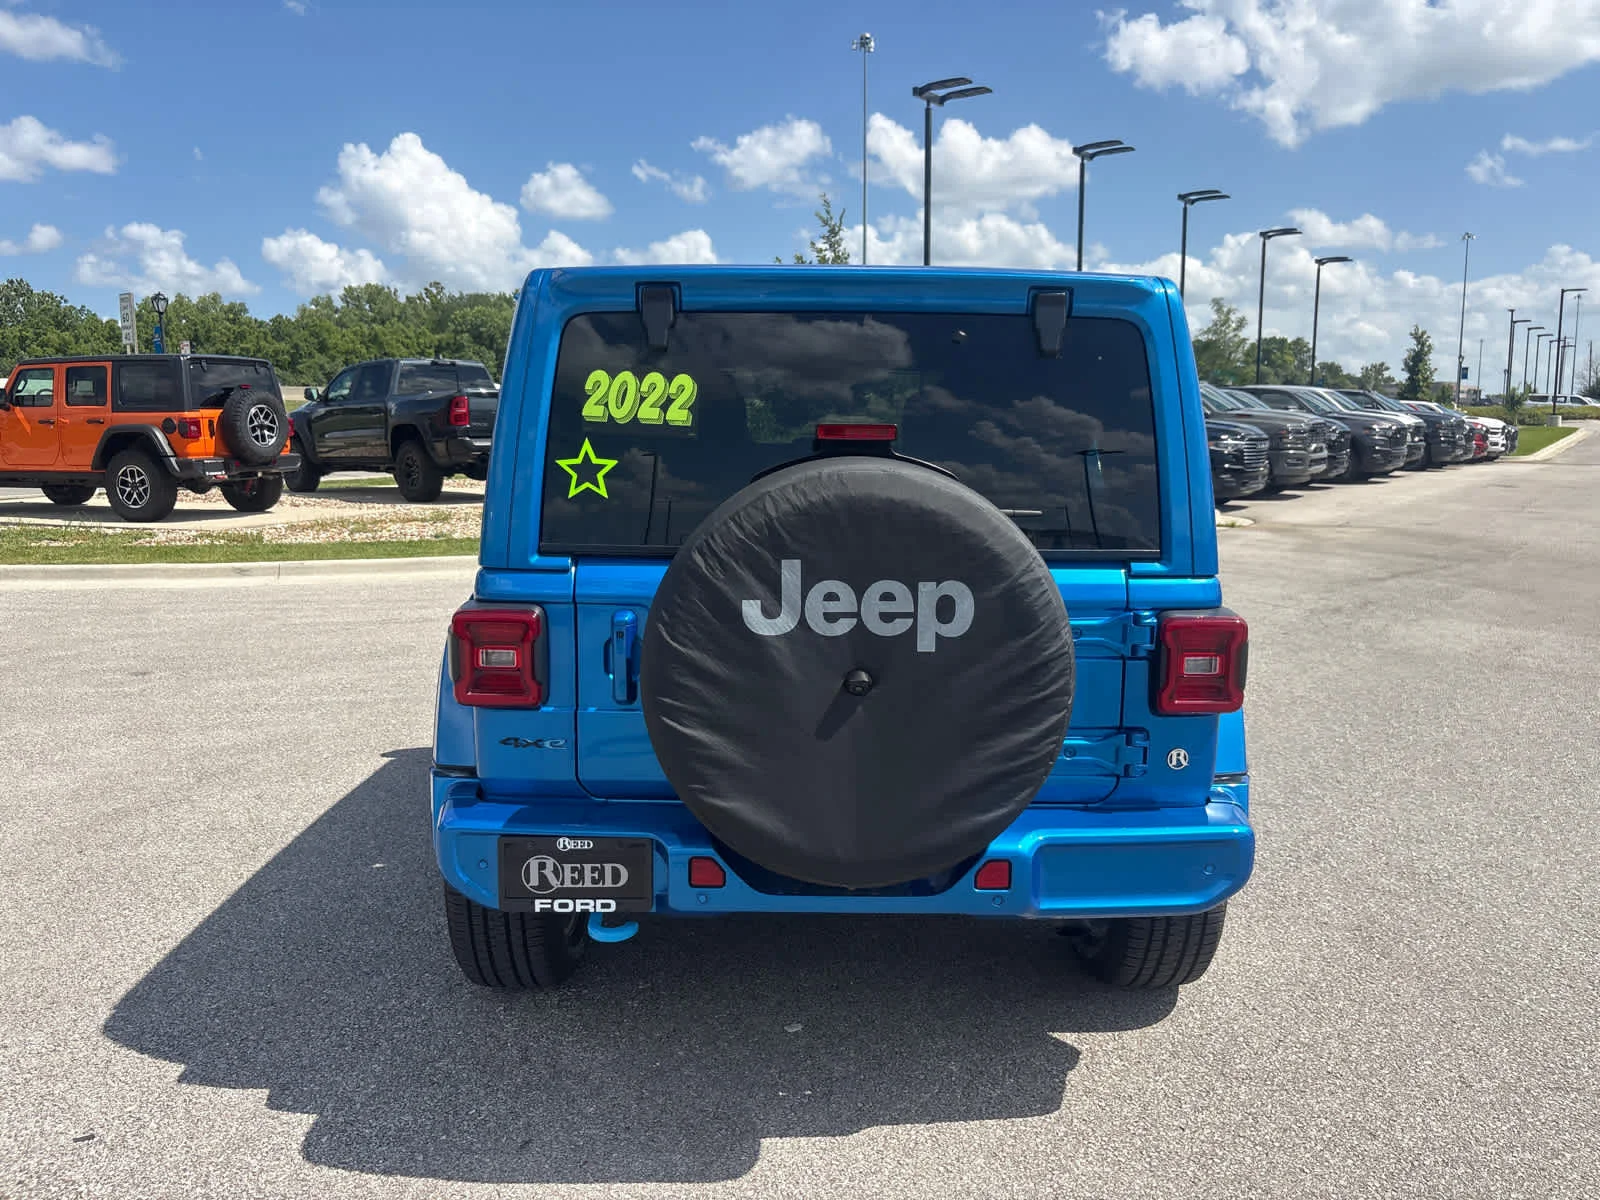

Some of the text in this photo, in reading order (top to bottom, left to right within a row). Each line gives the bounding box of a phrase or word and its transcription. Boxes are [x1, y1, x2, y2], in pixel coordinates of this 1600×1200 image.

[582, 369, 698, 427] 2022
[741, 559, 975, 653] Jeep
[558, 837, 594, 851] REED
[523, 856, 629, 892] REED
[534, 898, 616, 913] FORD
